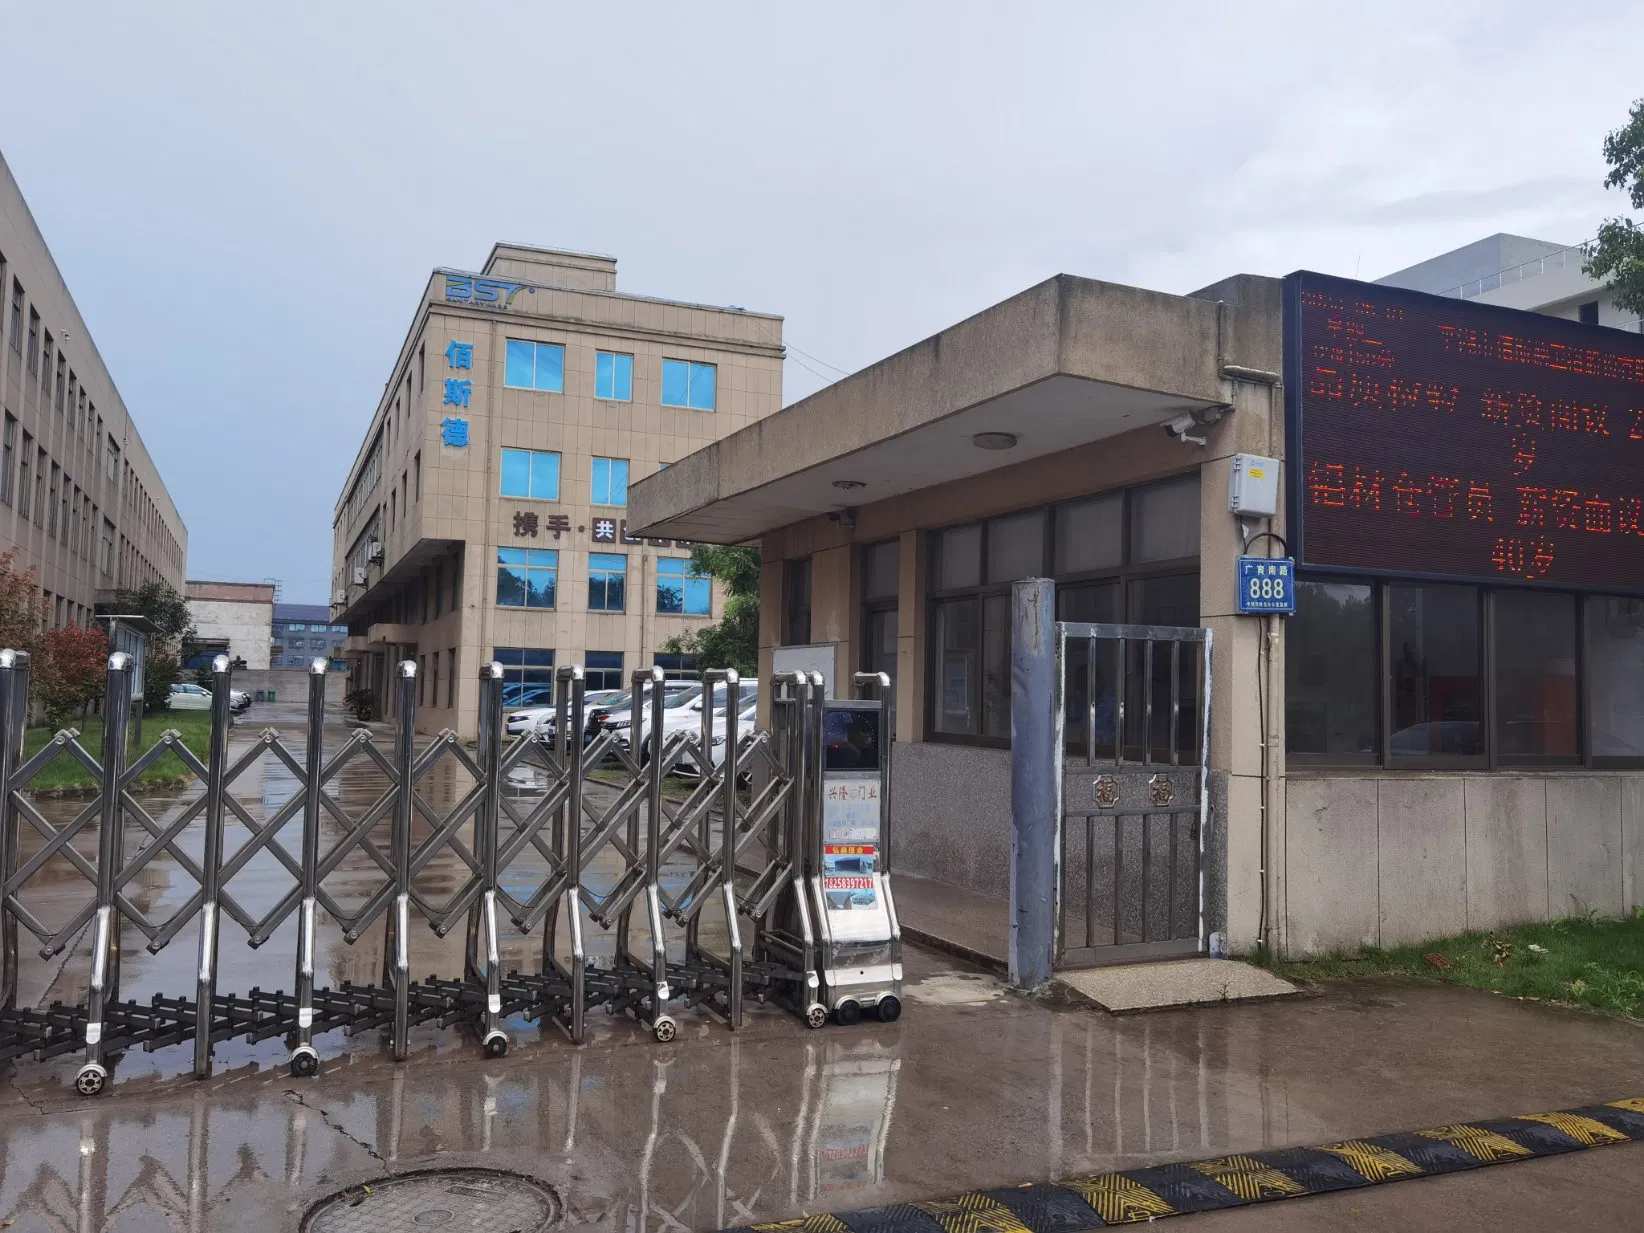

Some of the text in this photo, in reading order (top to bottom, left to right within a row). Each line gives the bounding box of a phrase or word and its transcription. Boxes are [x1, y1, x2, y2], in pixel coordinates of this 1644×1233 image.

[441, 340, 474, 447] 佰斯德
[1249, 577, 1285, 600] 888
[859, 785, 877, 800] 门业
[825, 878, 873, 889] 18258397217
